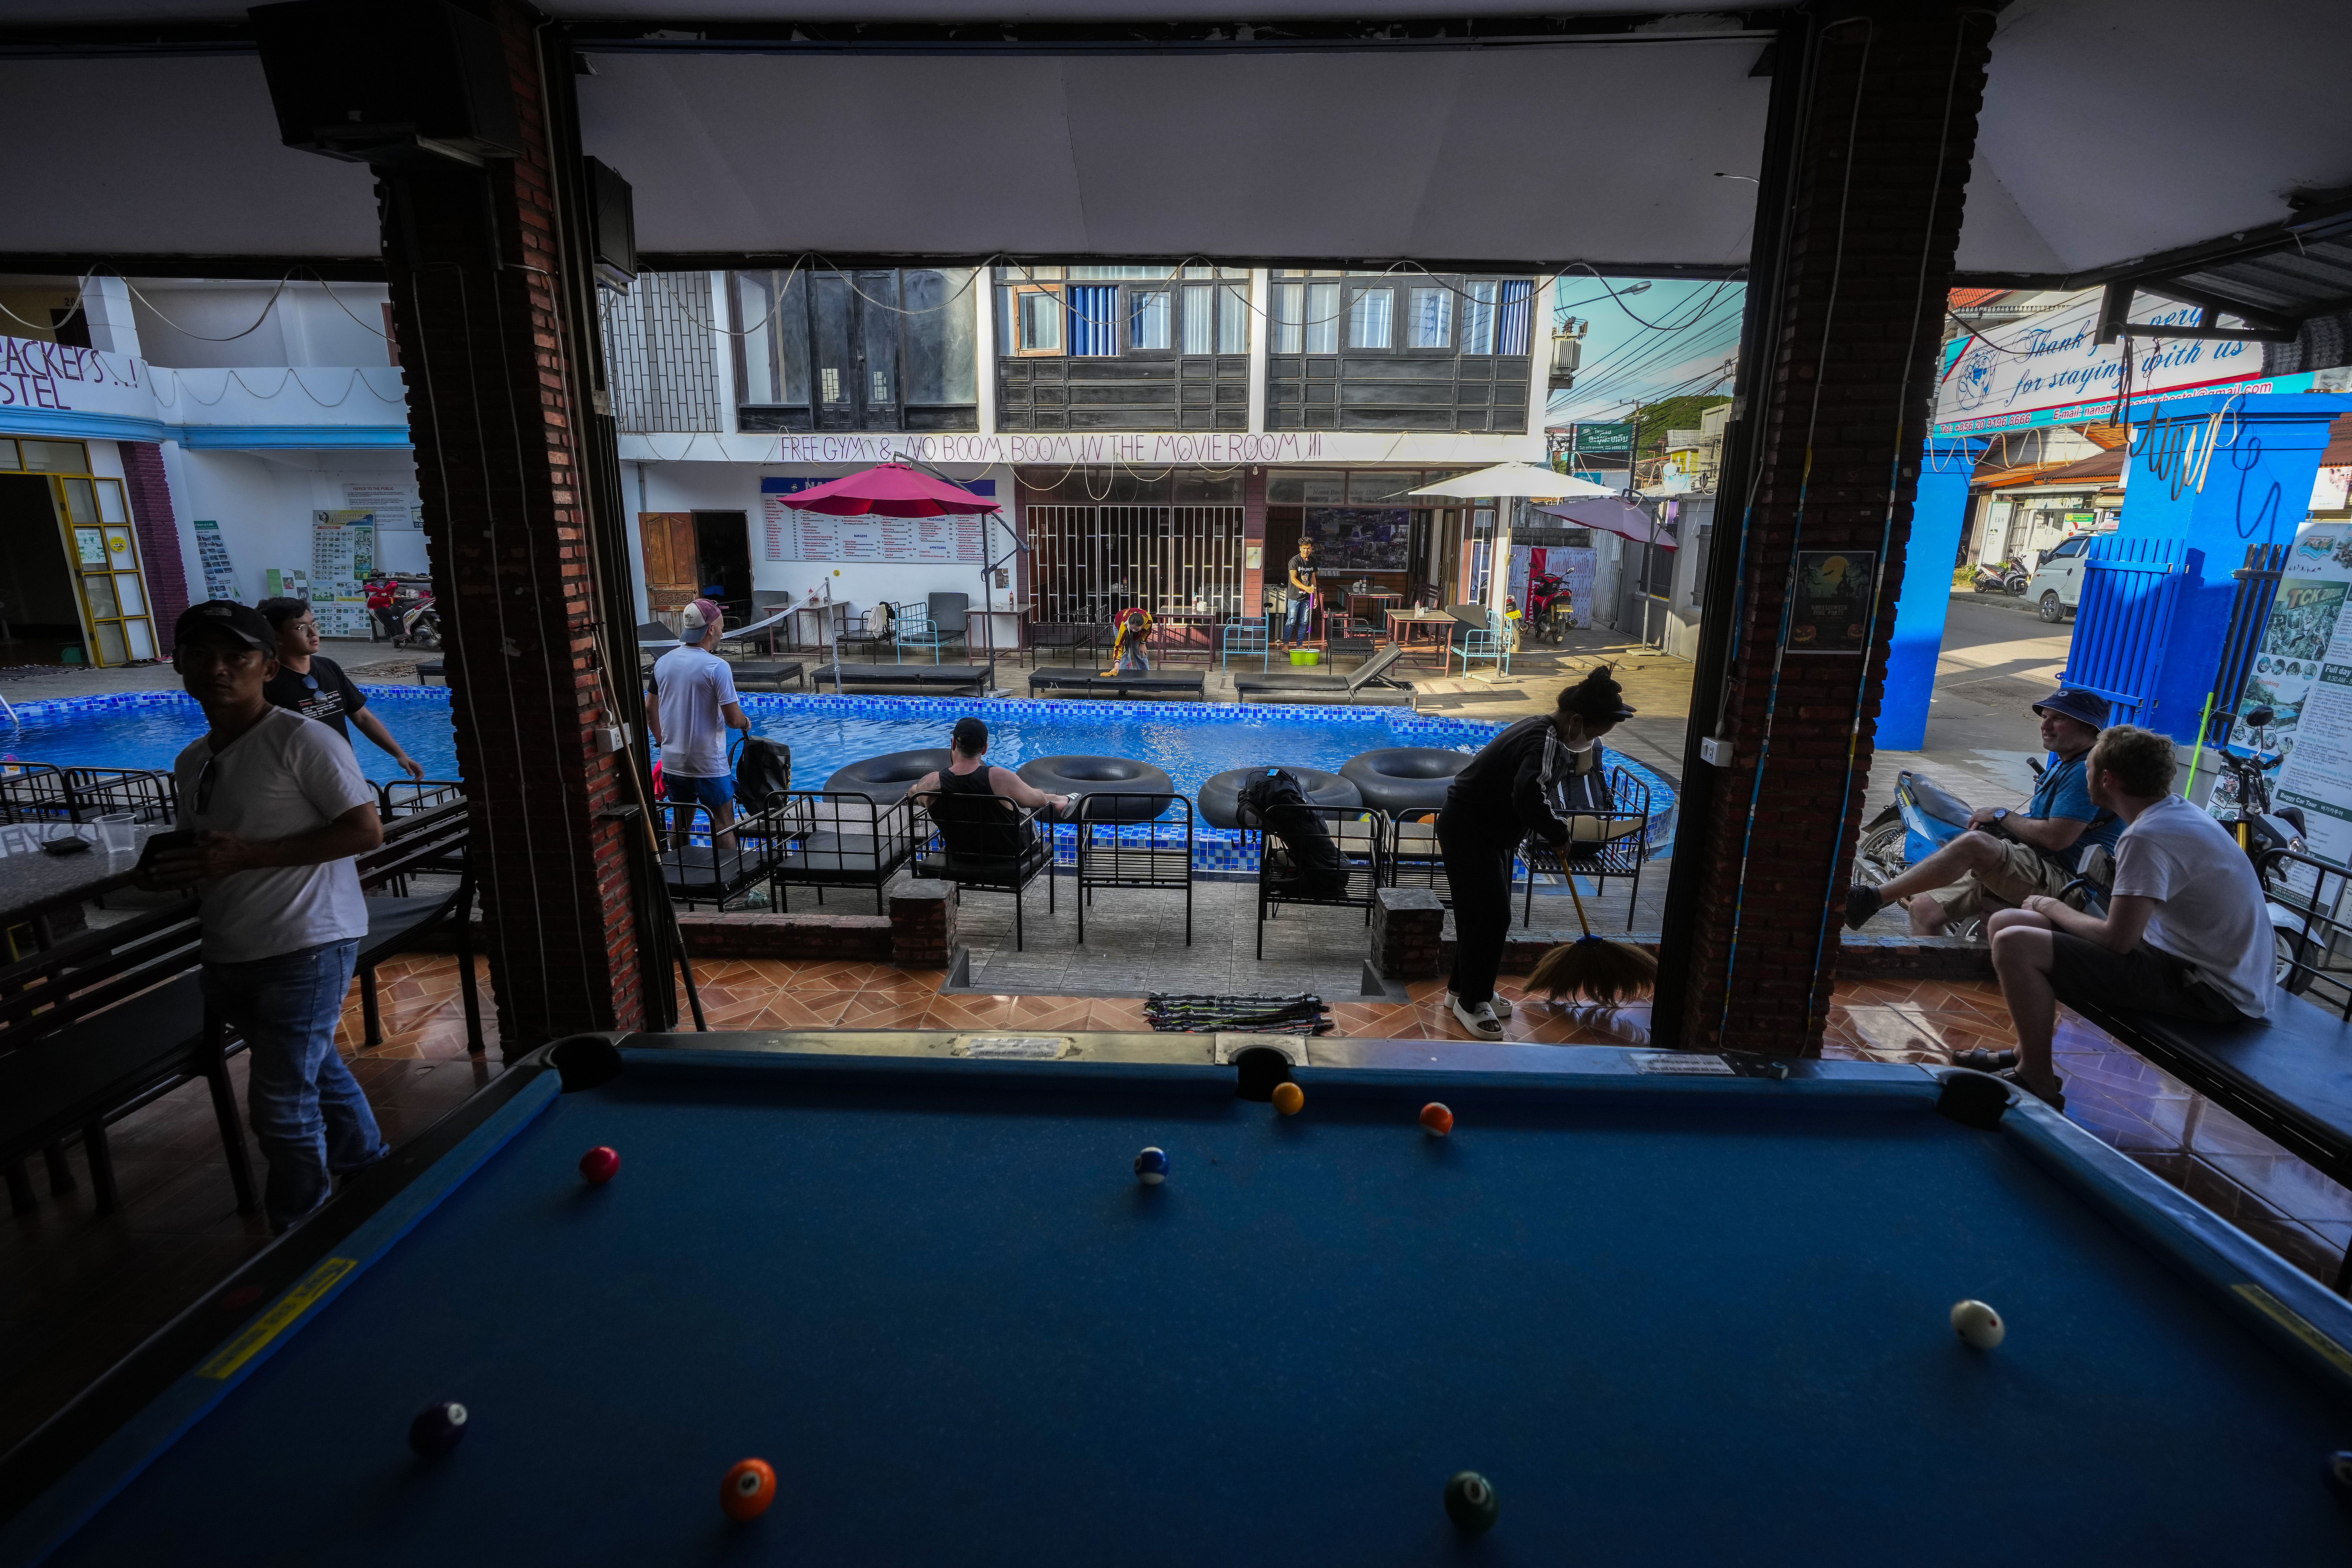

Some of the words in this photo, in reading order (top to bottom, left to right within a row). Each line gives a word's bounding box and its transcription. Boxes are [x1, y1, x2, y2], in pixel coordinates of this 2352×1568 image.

[2013, 320, 2091, 365] Thank
[2004, 369, 2045, 407] for
[2049, 359, 2134, 395] staying
[2142, 340, 2205, 372] with
[1940, 425, 1953, 434] Tel:
[1955, 421, 1973, 432] +856
[1975, 420, 1984, 430] 20
[1987, 417, 2006, 428] 9196
[2009, 414, 2031, 425] 8666
[2053, 408, 2082, 420] E-mail:
[782, 436, 819, 461] FREE
[824, 436, 865, 460] GYM
[880, 437, 891, 460] &
[906, 436, 936, 461] NO
[944, 436, 1004, 461] BOOM
[1012, 436, 1074, 462] BOOM
[1081, 435, 1103, 461] IN
[1109, 435, 1145, 461] THE
[1230, 434, 1299, 460] ROOM
[2287, 589, 2321, 609] TCK
[2325, 665, 2338, 673] Full
[2339, 668, 2352, 677] day
[2257, 679, 2279, 688] Kayaking
[2280, 792, 2296, 802] Buggy
